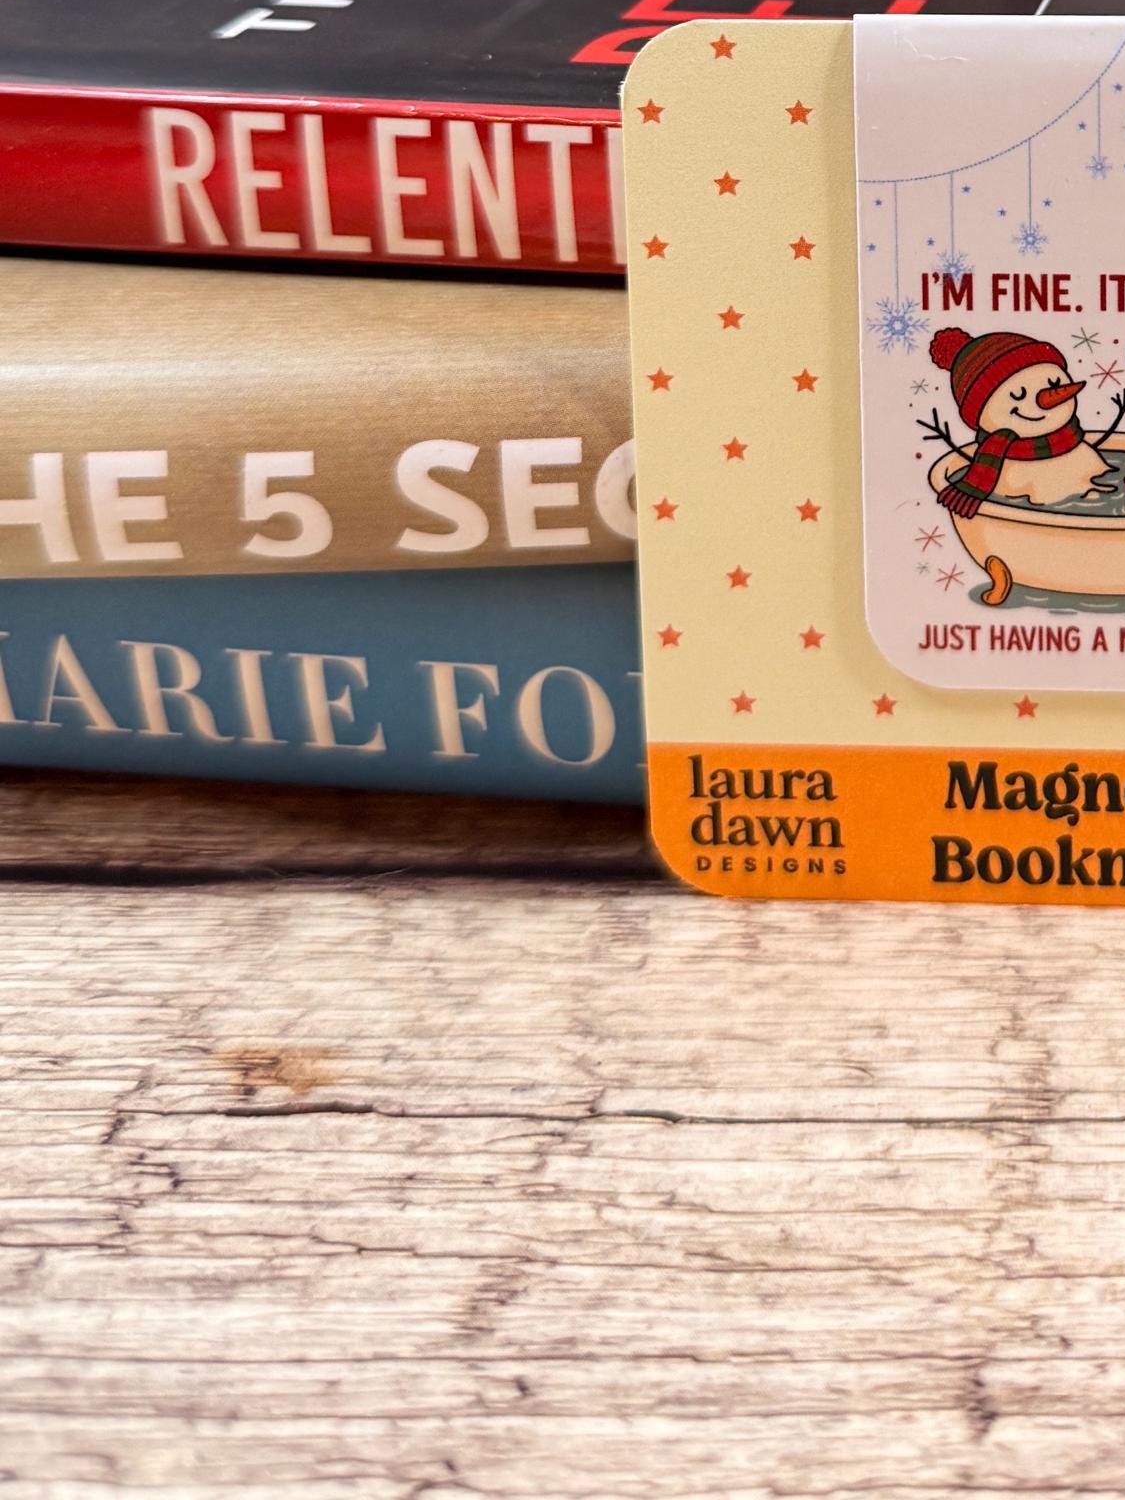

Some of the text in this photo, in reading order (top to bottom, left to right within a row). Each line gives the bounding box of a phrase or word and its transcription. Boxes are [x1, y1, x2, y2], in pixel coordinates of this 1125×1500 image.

[149, 105, 628, 266] RELENT
[921, 272, 974, 312] I'M
[991, 272, 1084, 313] FINE.
[241, 450, 334, 558] 5
[918, 624, 982, 652] JUST
[989, 624, 1081, 652] HAVING
[1091, 626, 1109, 652] A
[416, 660, 648, 769] FO
[687, 753, 839, 801] laura
[690, 800, 846, 848] dawn
[696, 855, 848, 875] DESIGNS
